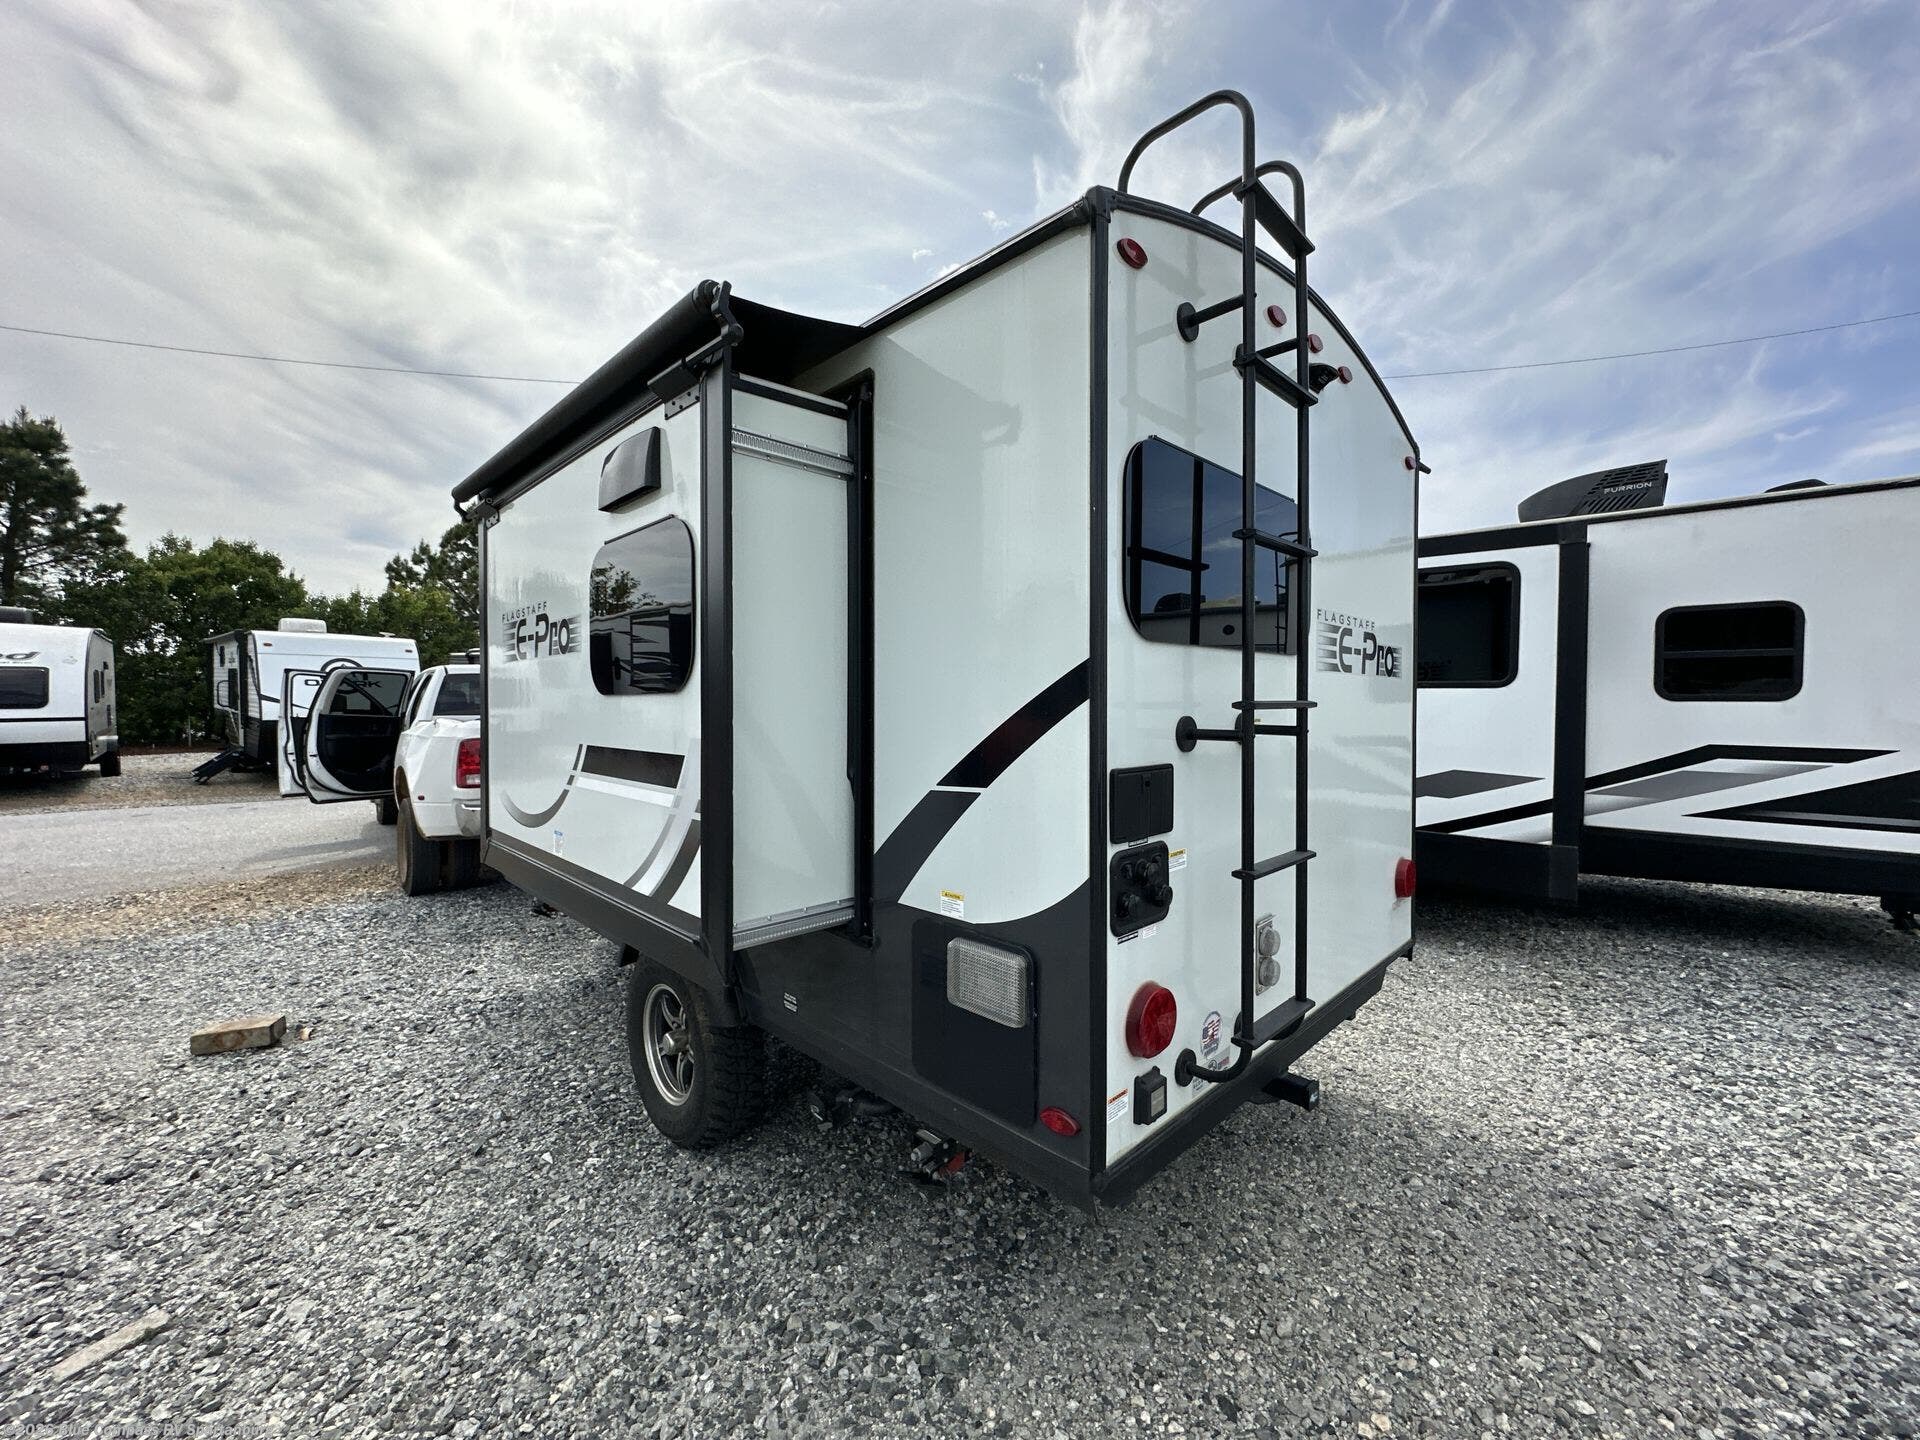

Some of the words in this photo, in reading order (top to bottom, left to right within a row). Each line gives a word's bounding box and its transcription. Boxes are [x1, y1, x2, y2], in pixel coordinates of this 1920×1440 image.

[1603, 481, 1652, 494] FURRION
[501, 601, 547, 622] FLAGSTAFF
[1316, 608, 1375, 631] FLAGSTAFF
